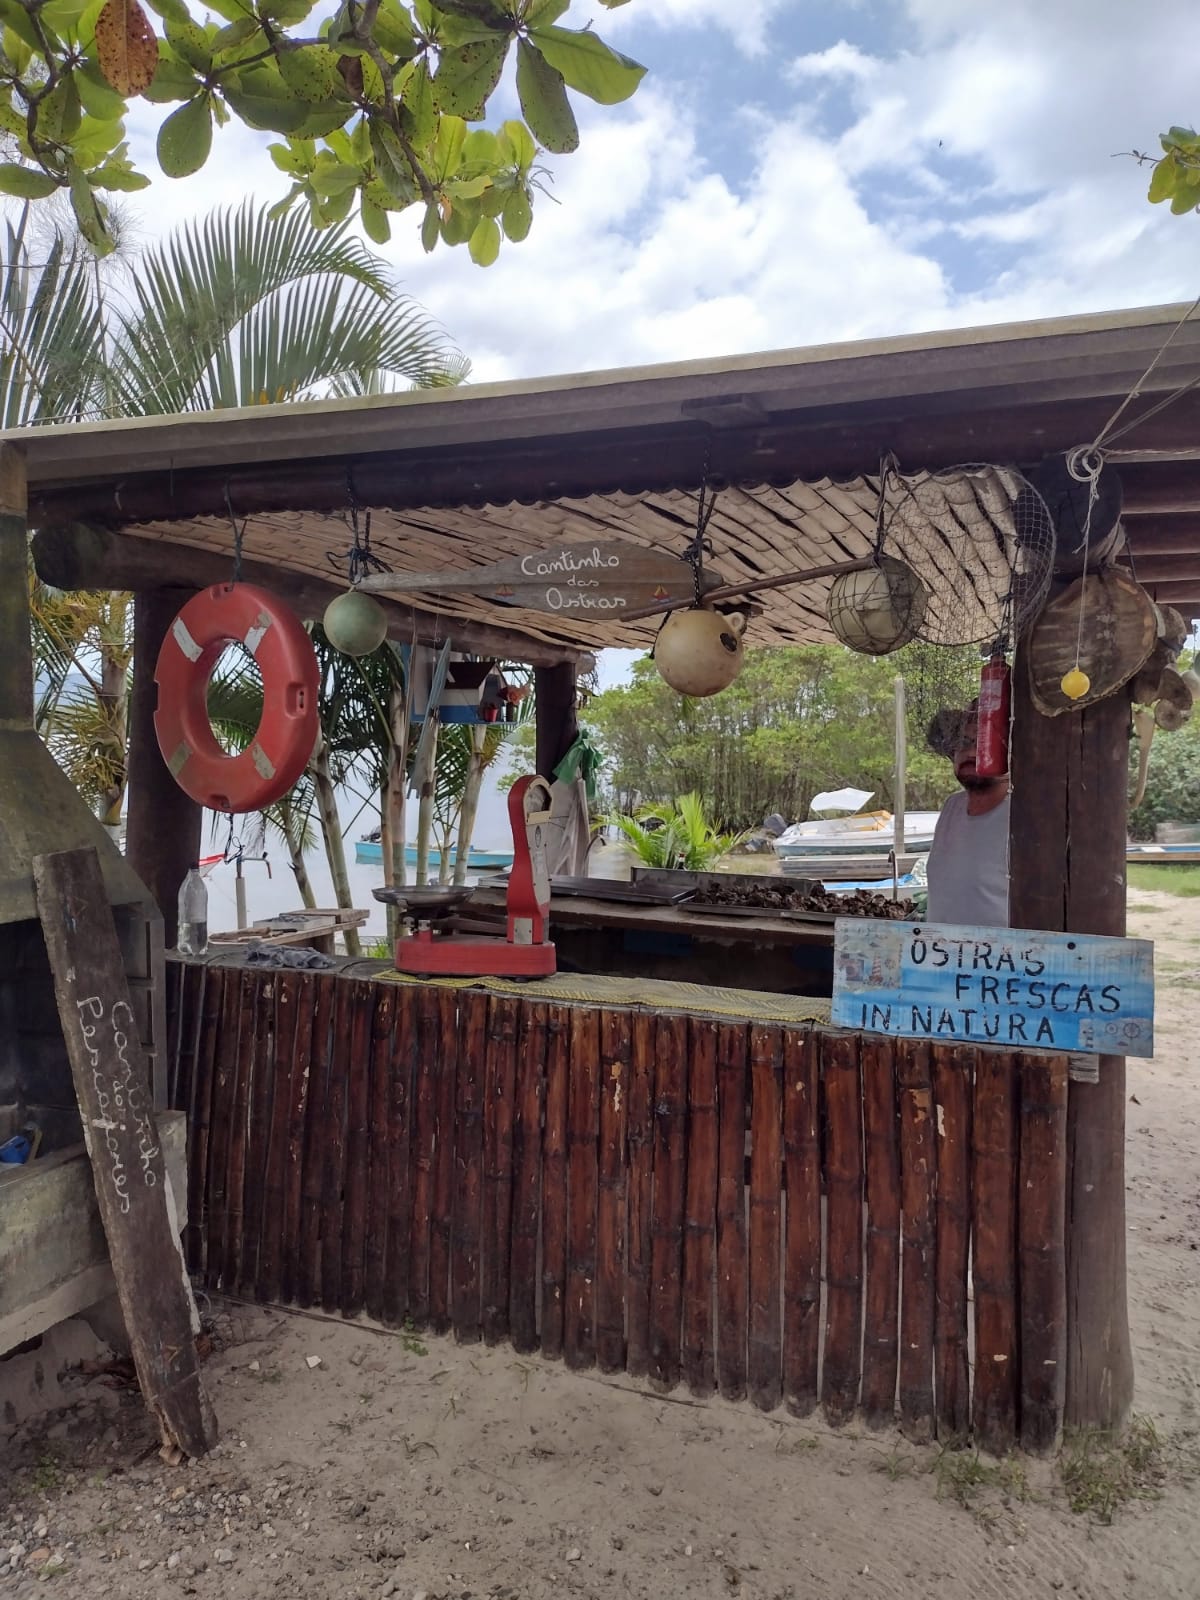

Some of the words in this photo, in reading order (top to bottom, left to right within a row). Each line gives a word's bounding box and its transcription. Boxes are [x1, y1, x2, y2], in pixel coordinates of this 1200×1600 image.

[521, 547, 620, 576] Cantinho
[567, 574, 600, 587] das
[545, 587, 627, 610] Ostras
[910, 939, 1046, 977] OSTRAS
[955, 974, 1122, 1014] FRESCAS
[911, 1004, 1055, 1043] NATURA
[111, 1000, 160, 1187] Cantinho
